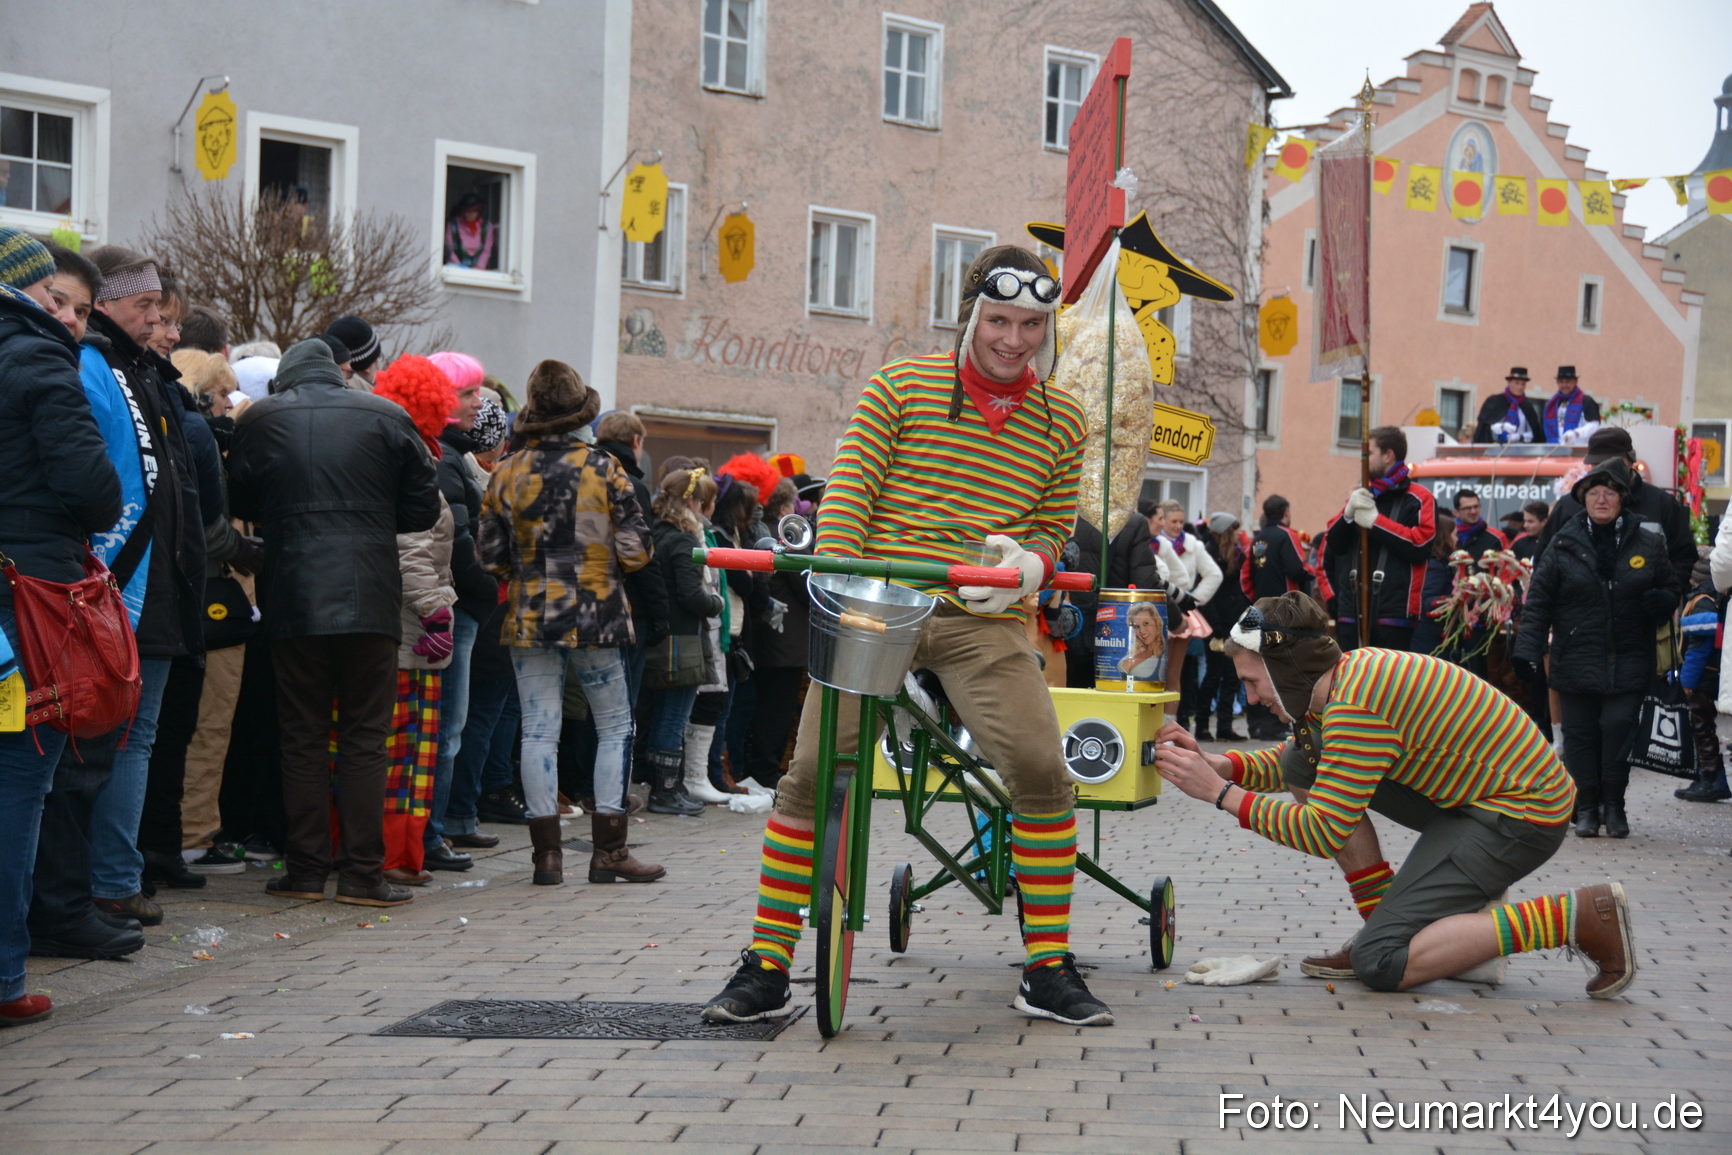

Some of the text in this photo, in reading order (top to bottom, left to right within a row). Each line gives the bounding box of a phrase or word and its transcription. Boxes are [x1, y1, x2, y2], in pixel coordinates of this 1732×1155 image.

[691, 314, 866, 379] Konditorei
[112, 368, 159, 495] DAIKIN EU
[1150, 424, 1204, 453] endorf
[1433, 481, 1551, 500] Prinzenpaar
[1647, 753, 1681, 765] monsters
